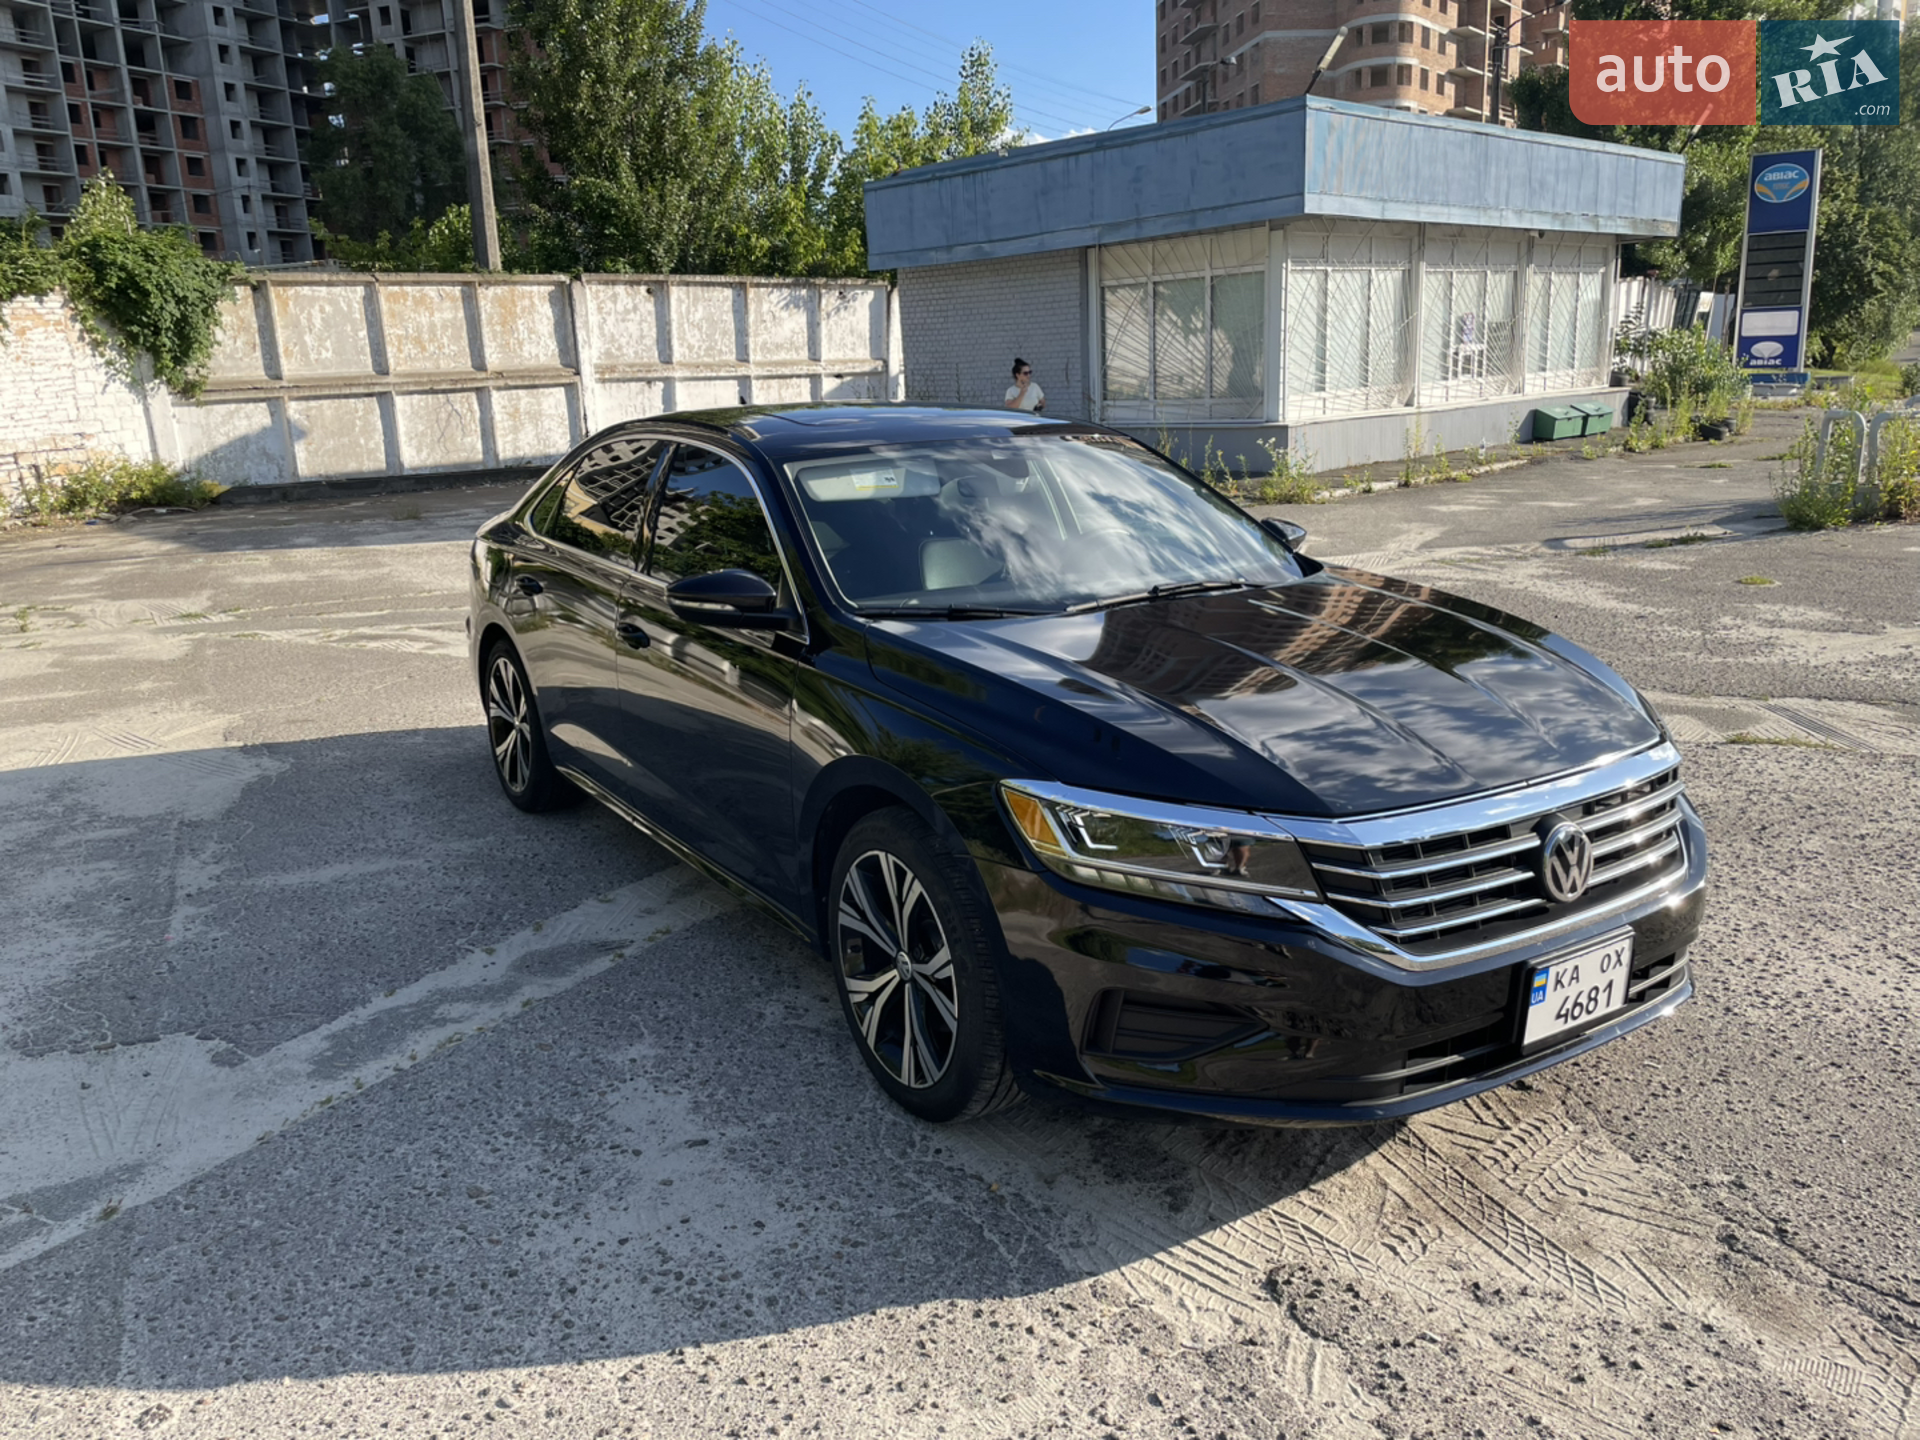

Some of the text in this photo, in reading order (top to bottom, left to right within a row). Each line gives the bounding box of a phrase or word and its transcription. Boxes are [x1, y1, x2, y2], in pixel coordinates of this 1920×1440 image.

[1553, 964, 1580, 993] KA
[1531, 990, 1544, 1004] UA
[1554, 979, 1614, 1025] 4681
